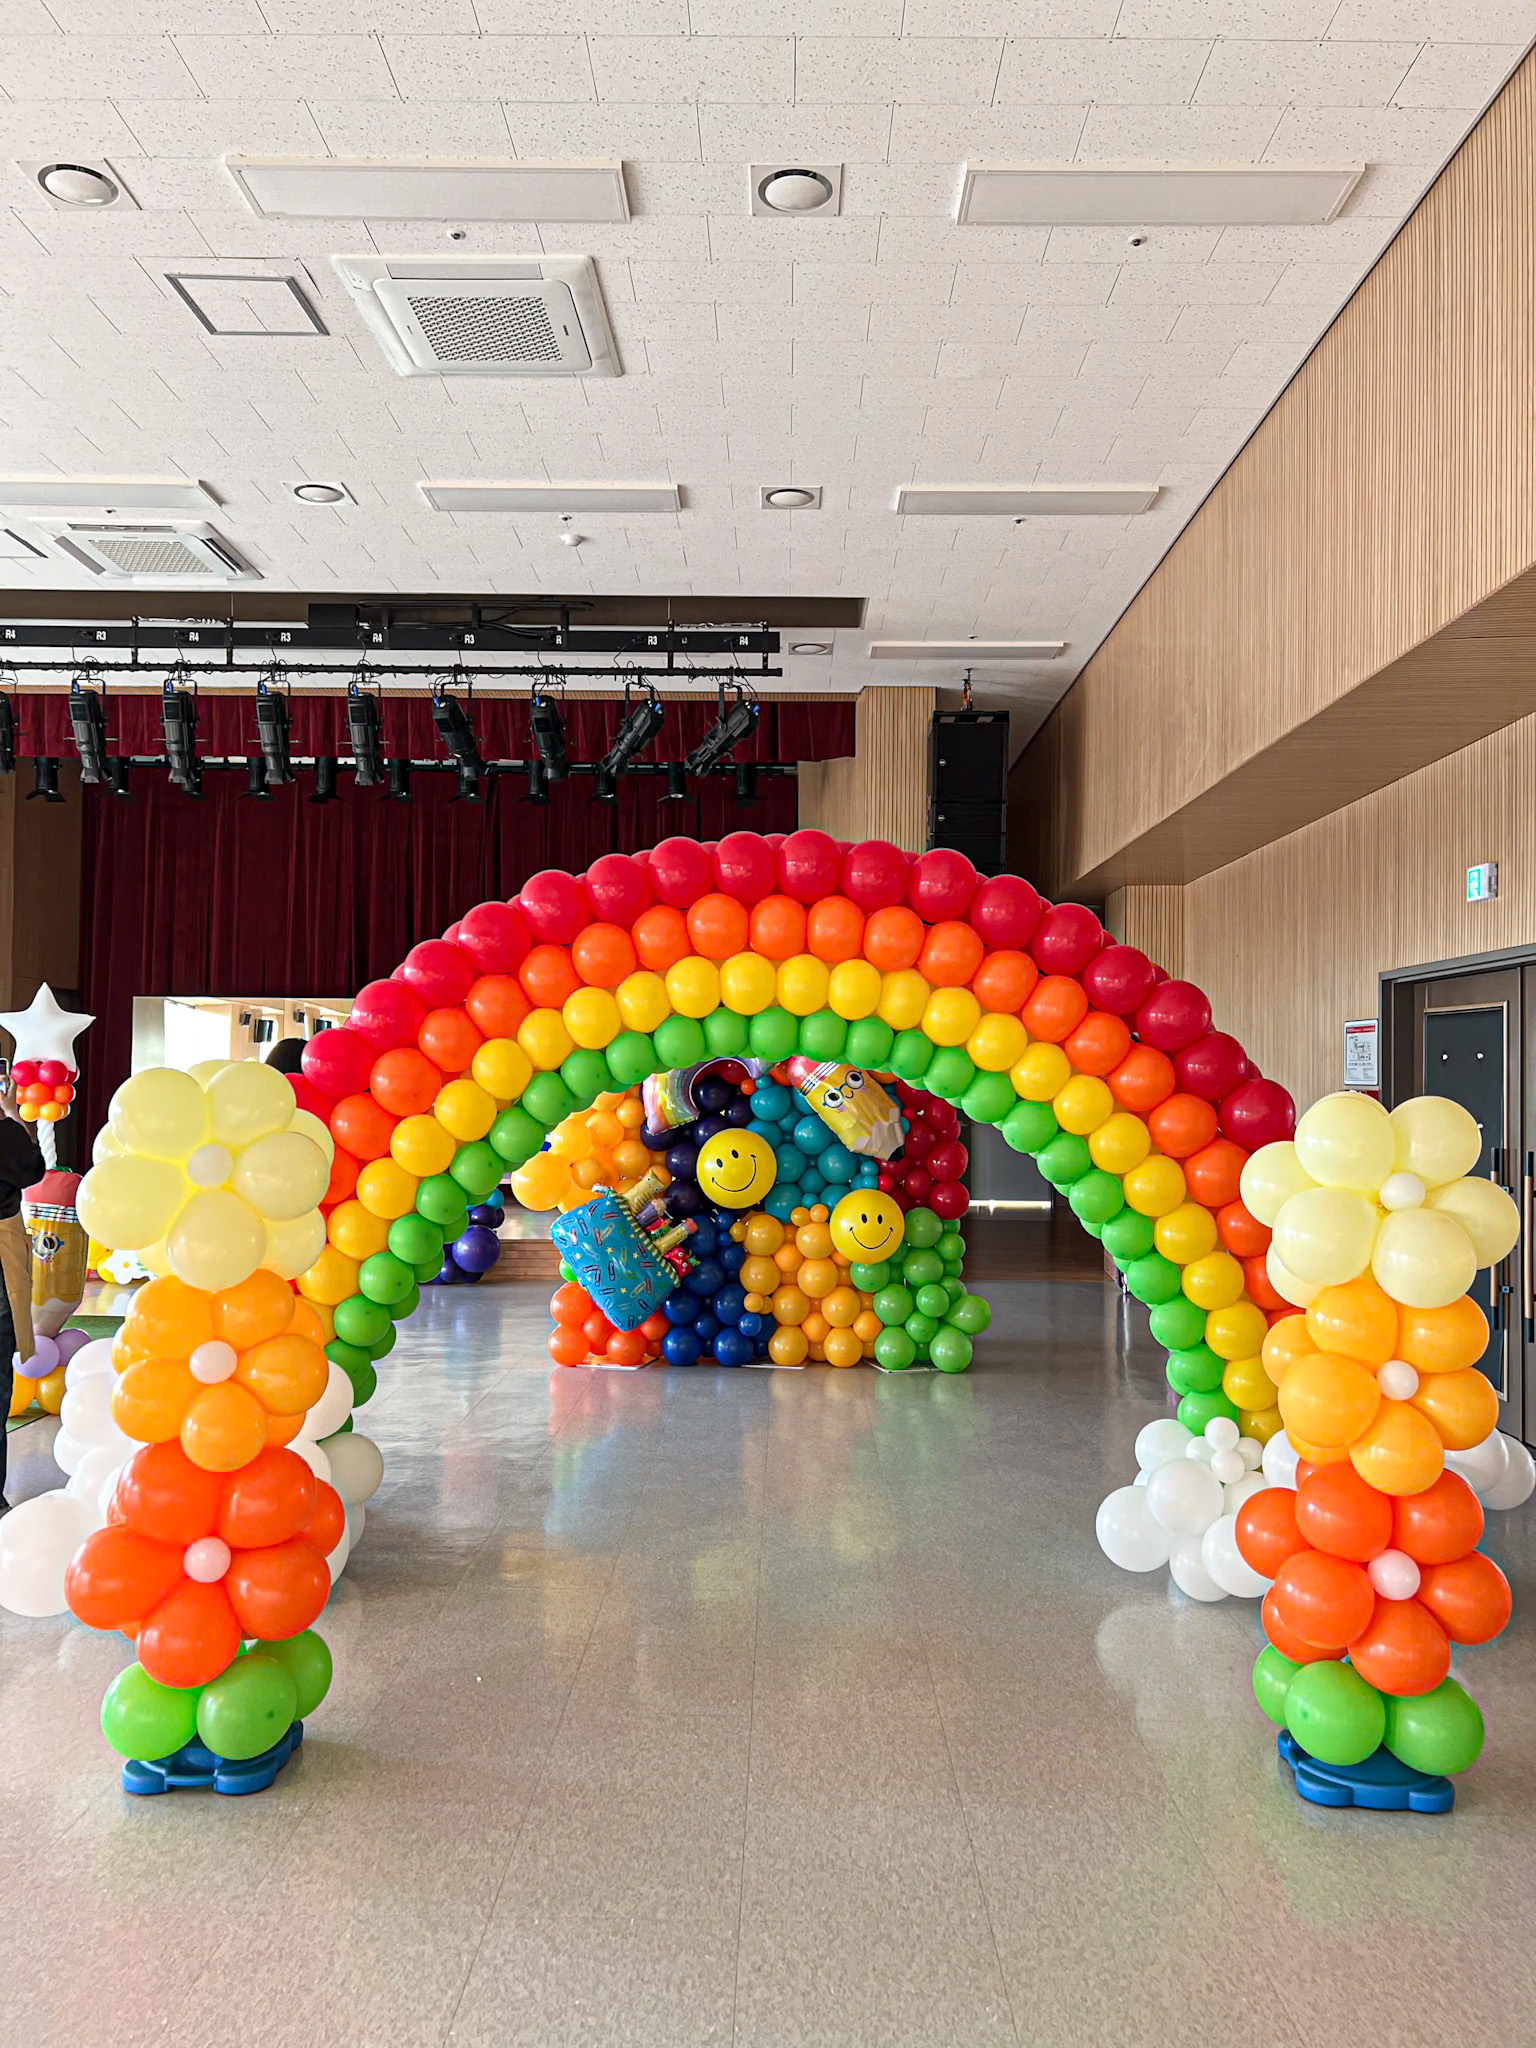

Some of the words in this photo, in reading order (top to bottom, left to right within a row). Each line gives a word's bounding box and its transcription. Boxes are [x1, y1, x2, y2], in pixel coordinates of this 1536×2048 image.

[5, 629, 16, 639] R4
[96, 631, 107, 641] R3
[189, 632, 199, 642] R4
[280, 632, 291, 642] R3
[372, 633, 383, 643] R4
[464, 634, 475, 644] R3
[647, 635, 658, 645] R3
[739, 636, 749, 646] R4
